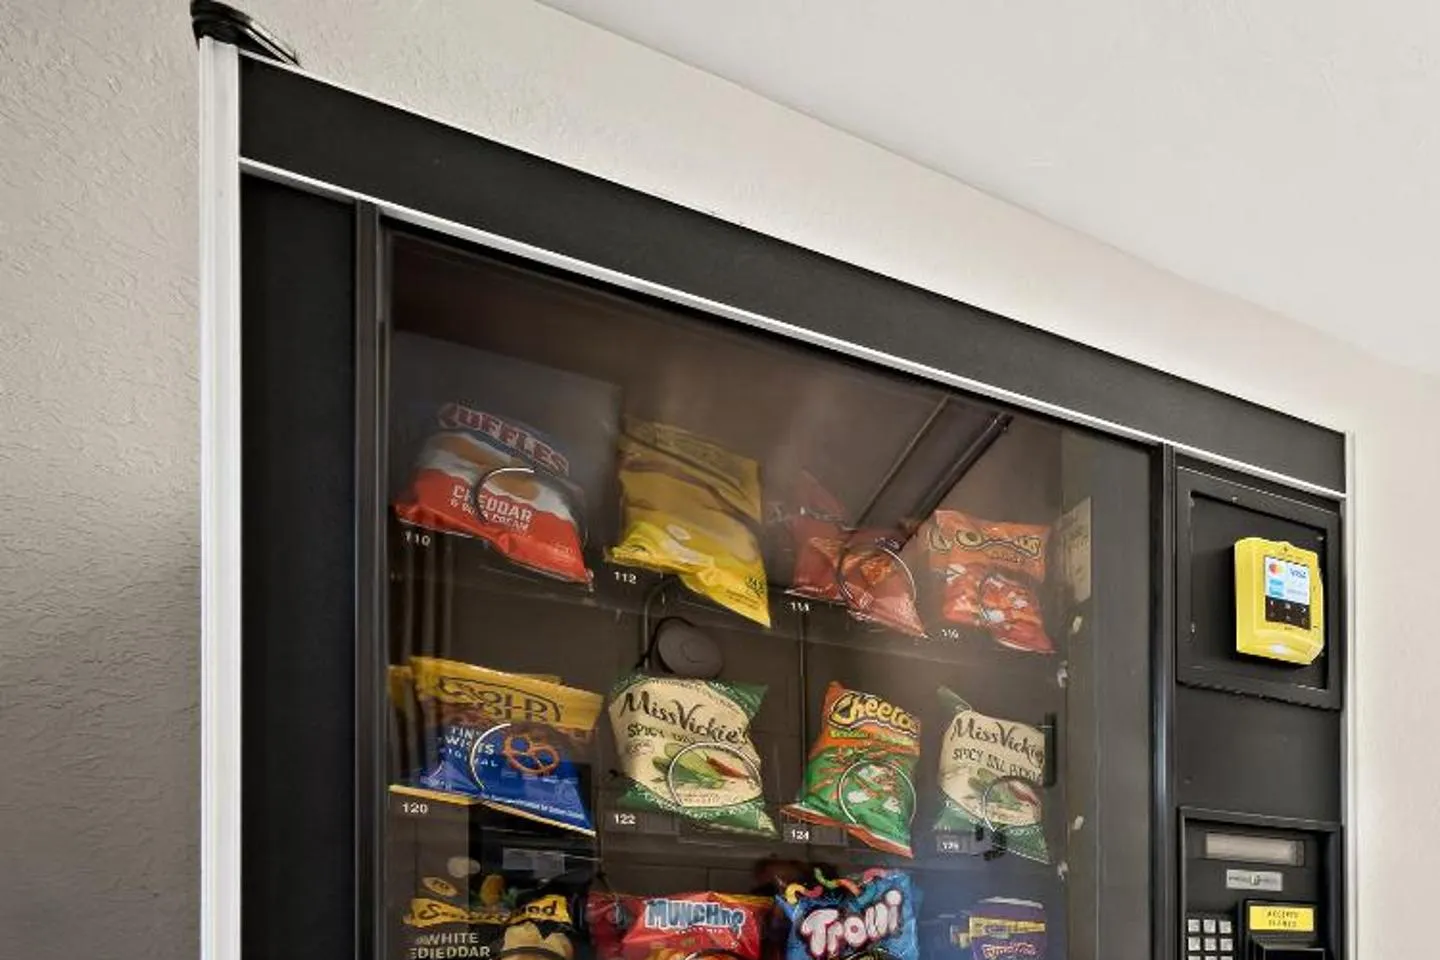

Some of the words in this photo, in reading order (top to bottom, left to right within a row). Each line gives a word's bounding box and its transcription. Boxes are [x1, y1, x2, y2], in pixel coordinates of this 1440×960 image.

[405, 531, 431, 547] 110
[614, 571, 637, 585] 112
[620, 691, 675, 723] Miss
[951, 718, 998, 744] Miss
[996, 722, 1045, 767] Vicki
[402, 802, 429, 815] 120
[613, 813, 636, 825] 122
[801, 889, 902, 957] Trolli
[428, 932, 479, 945] WHITE
